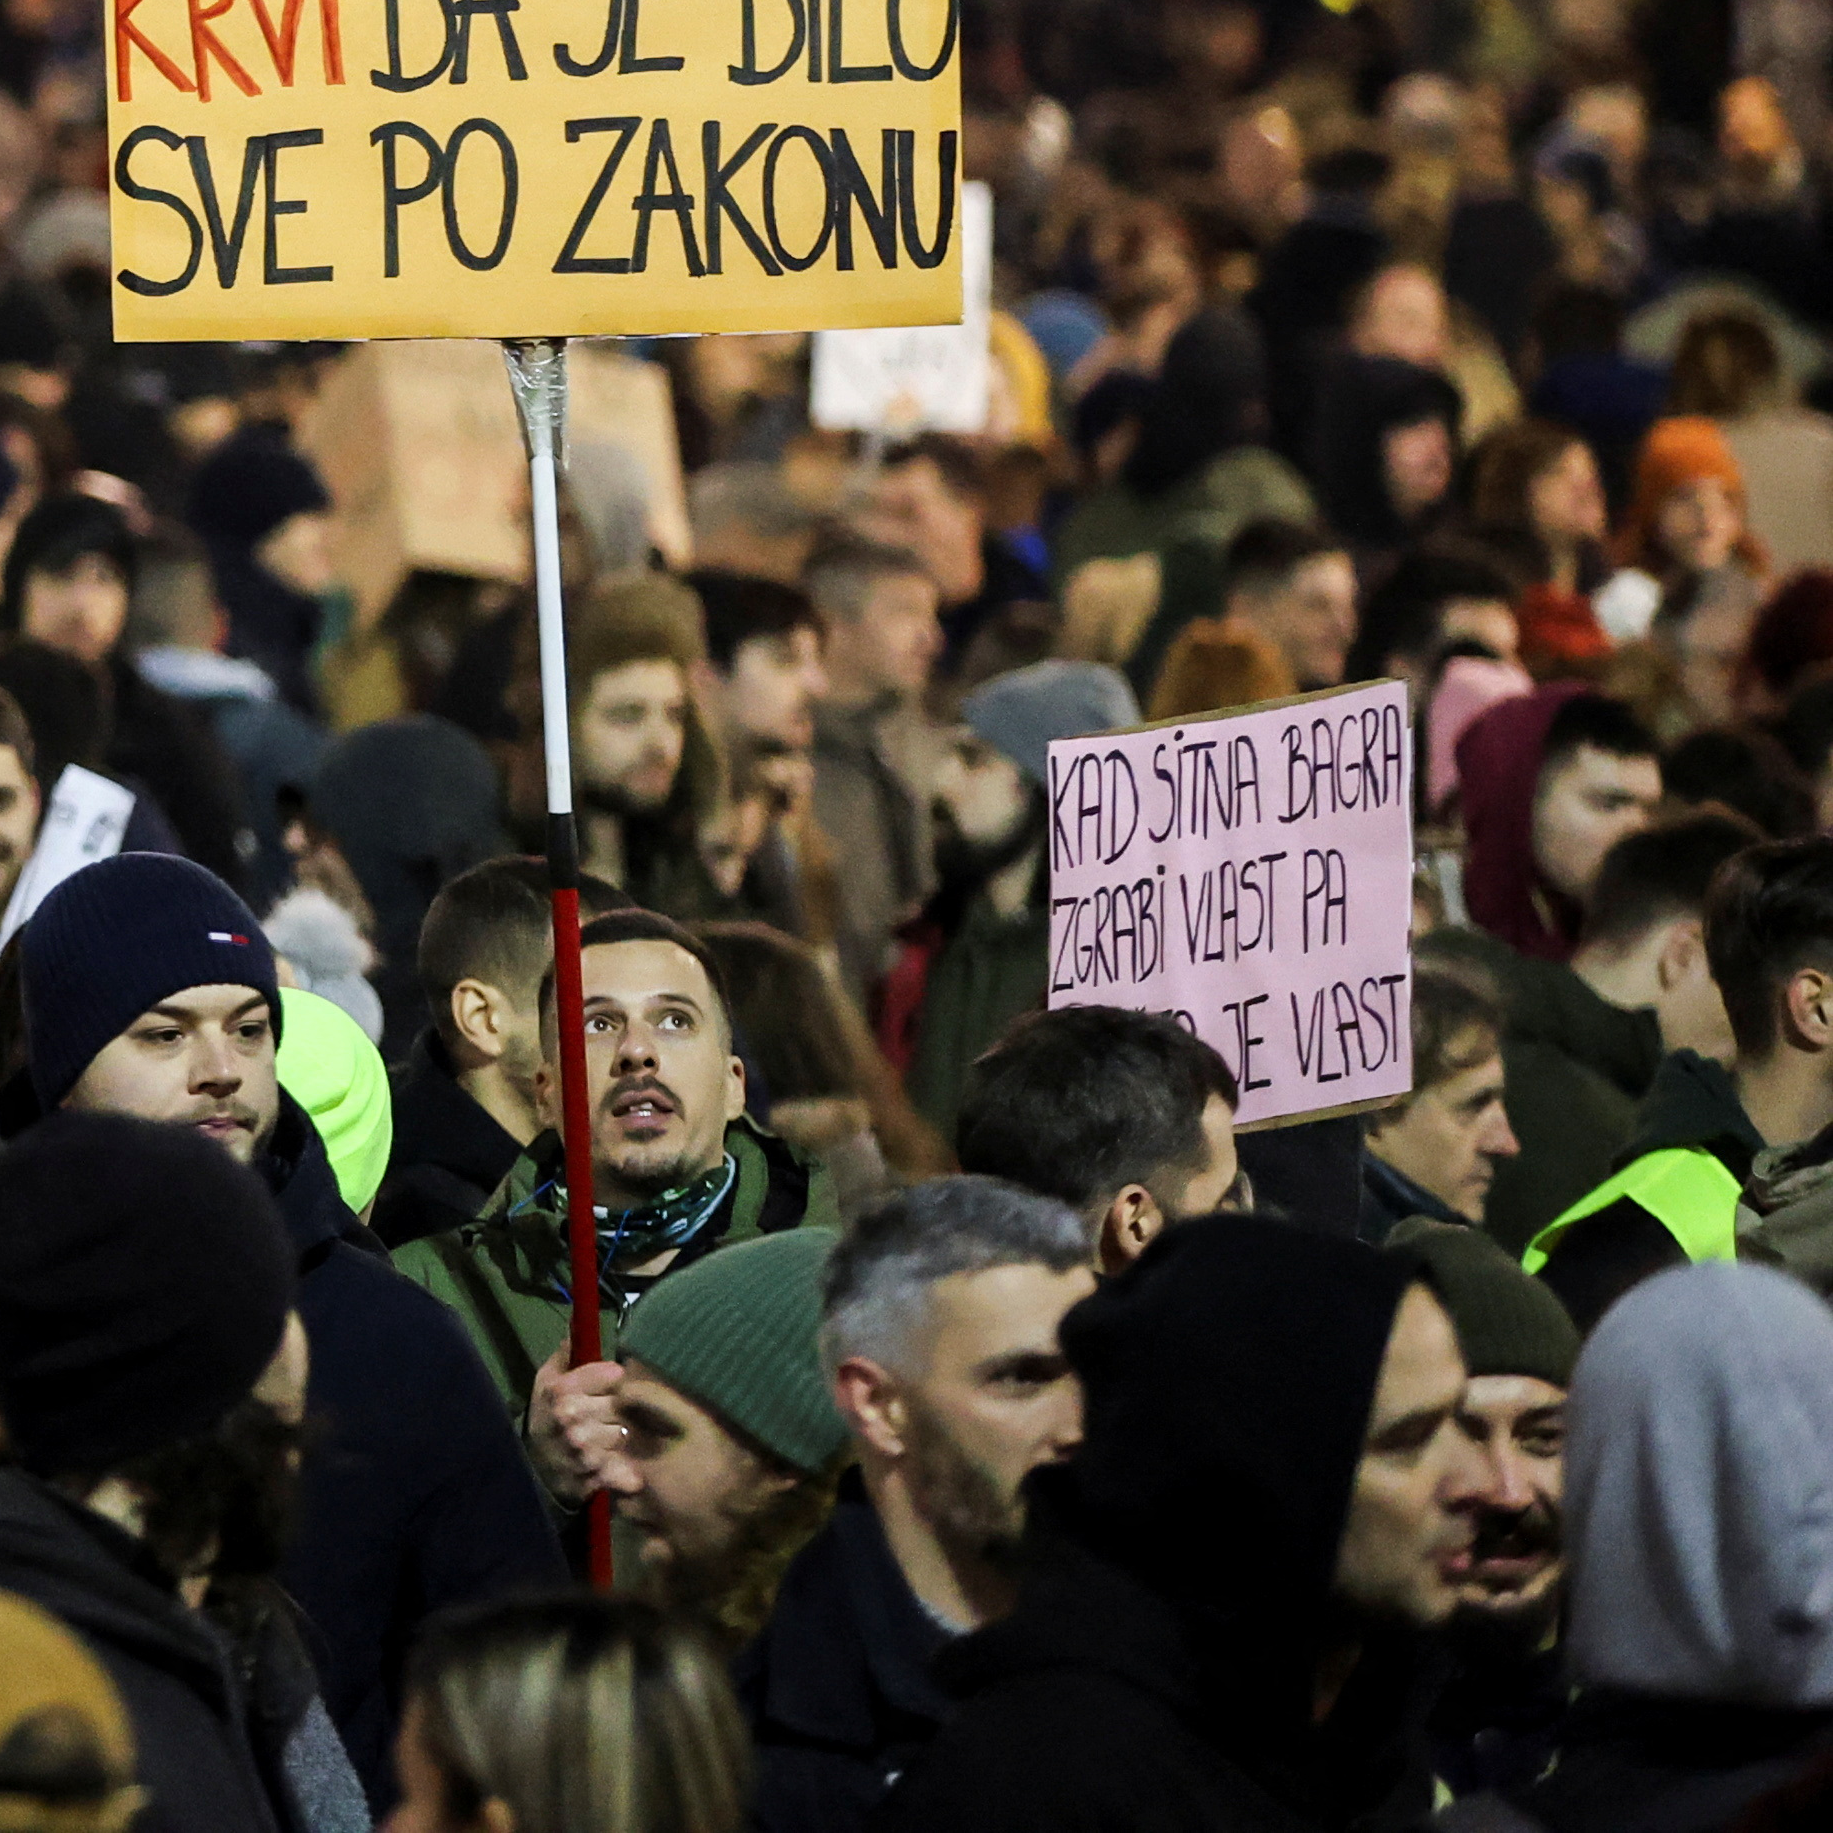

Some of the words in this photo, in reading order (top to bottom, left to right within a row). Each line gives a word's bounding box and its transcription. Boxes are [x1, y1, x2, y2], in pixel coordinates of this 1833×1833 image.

[114, 125, 334, 296] SVE
[370, 117, 519, 278] PO
[552, 117, 957, 278] ZAKONU
[1051, 748, 1139, 873] KAD
[1279, 704, 1403, 823] BAGRA
[1180, 851, 1288, 964] VLAST
[1303, 849, 1348, 954] PA
[1222, 994, 1271, 1093] JE
[1290, 974, 1406, 1083] VLAST
